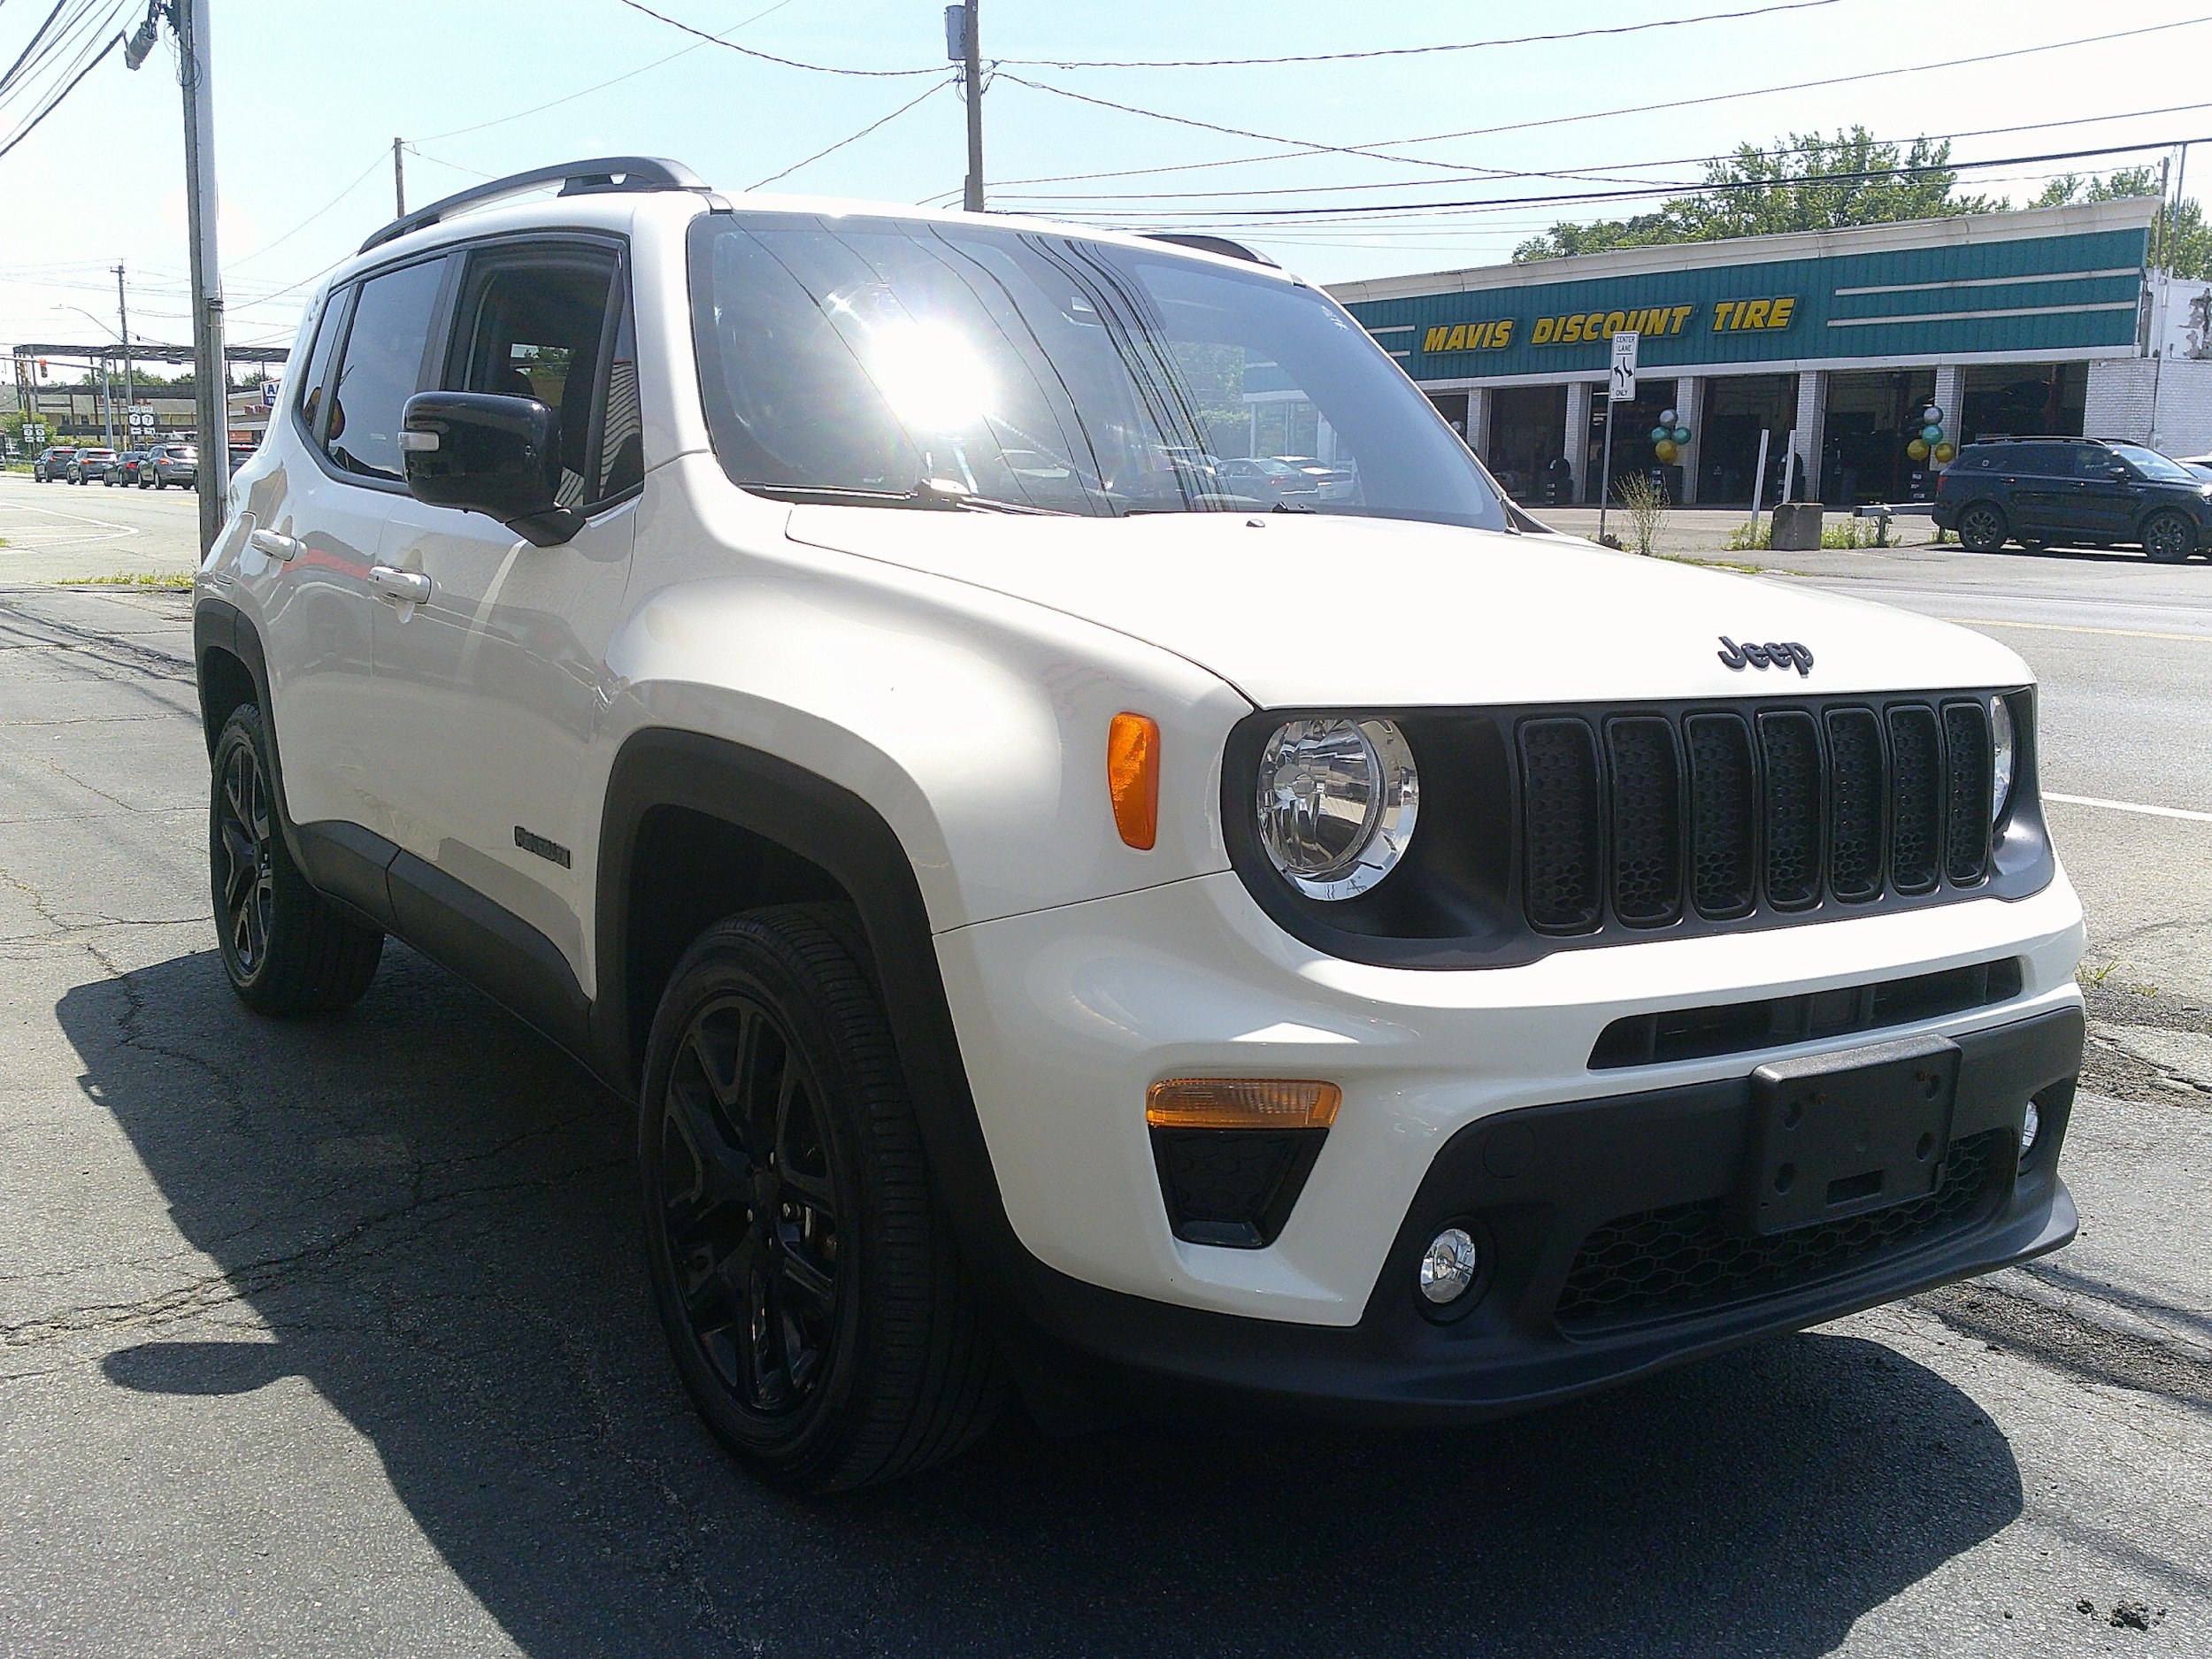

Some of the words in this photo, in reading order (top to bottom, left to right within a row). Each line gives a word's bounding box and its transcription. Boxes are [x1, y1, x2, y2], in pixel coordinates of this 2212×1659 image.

[1423, 319, 1513, 352] MAVIS
[1531, 305, 1693, 344] DISCOUNT
[1713, 297, 1796, 330] TIRE
[1717, 635, 1814, 676] Jeep
